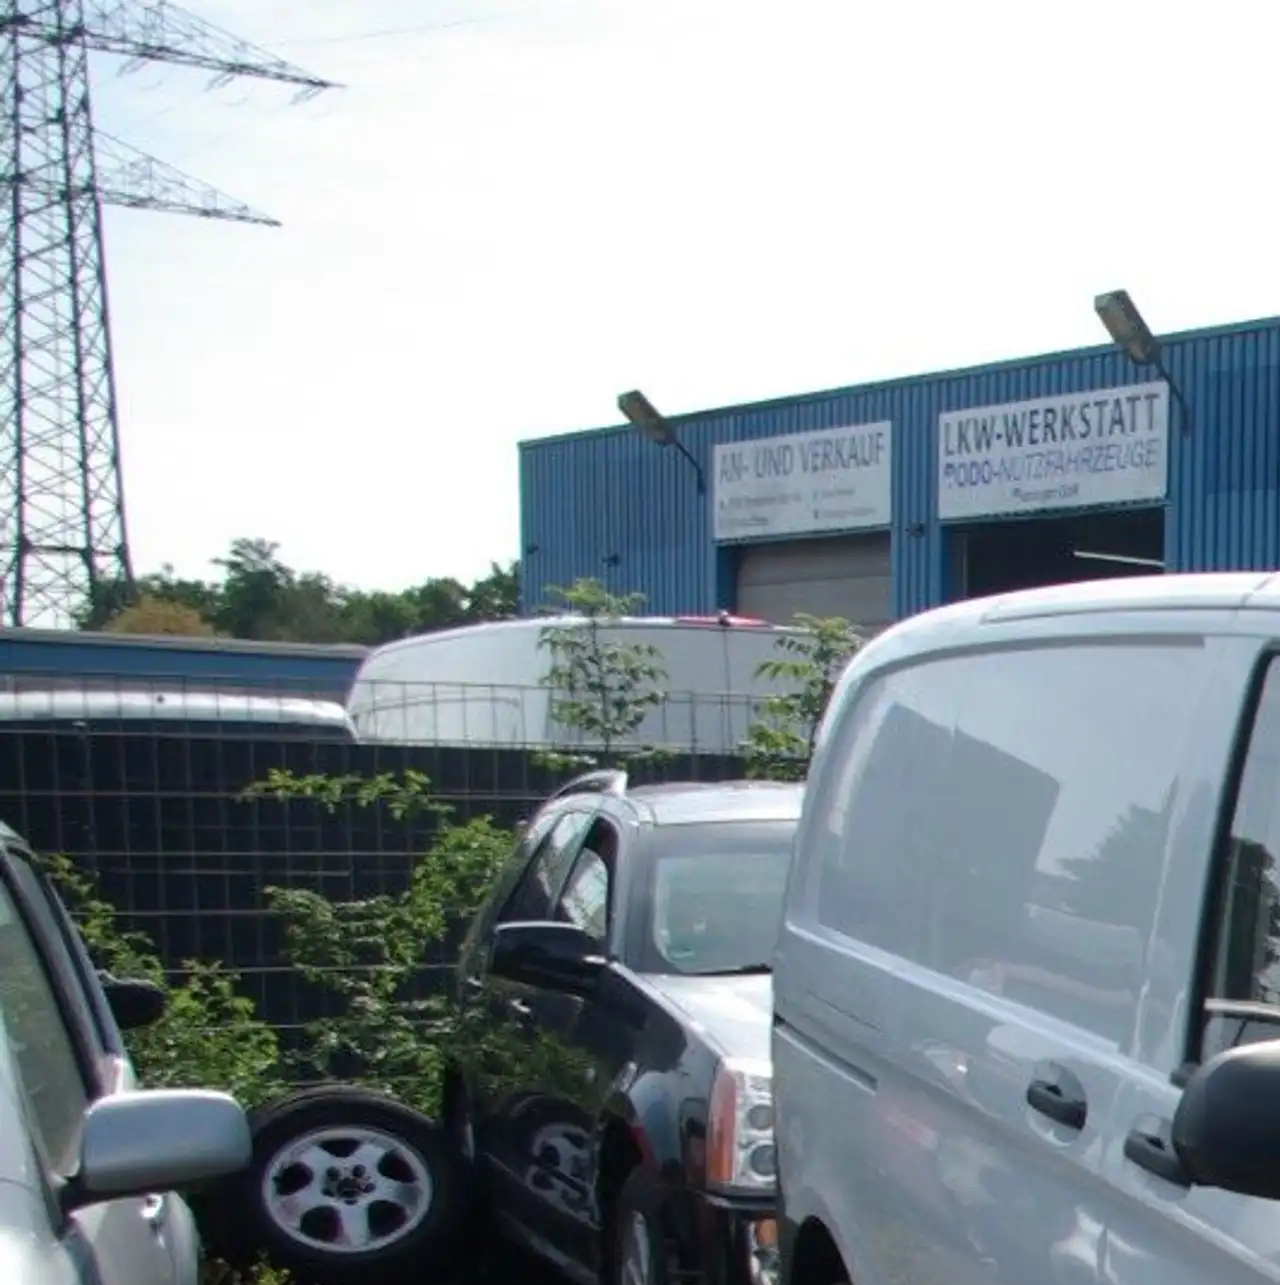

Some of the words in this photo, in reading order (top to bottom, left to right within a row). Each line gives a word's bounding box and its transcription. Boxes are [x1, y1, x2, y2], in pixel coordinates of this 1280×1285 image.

[943, 392, 1160, 457] LKW-WERKSTATT
[754, 443, 795, 478] UND
[801, 432, 885, 474] VERKAUF
